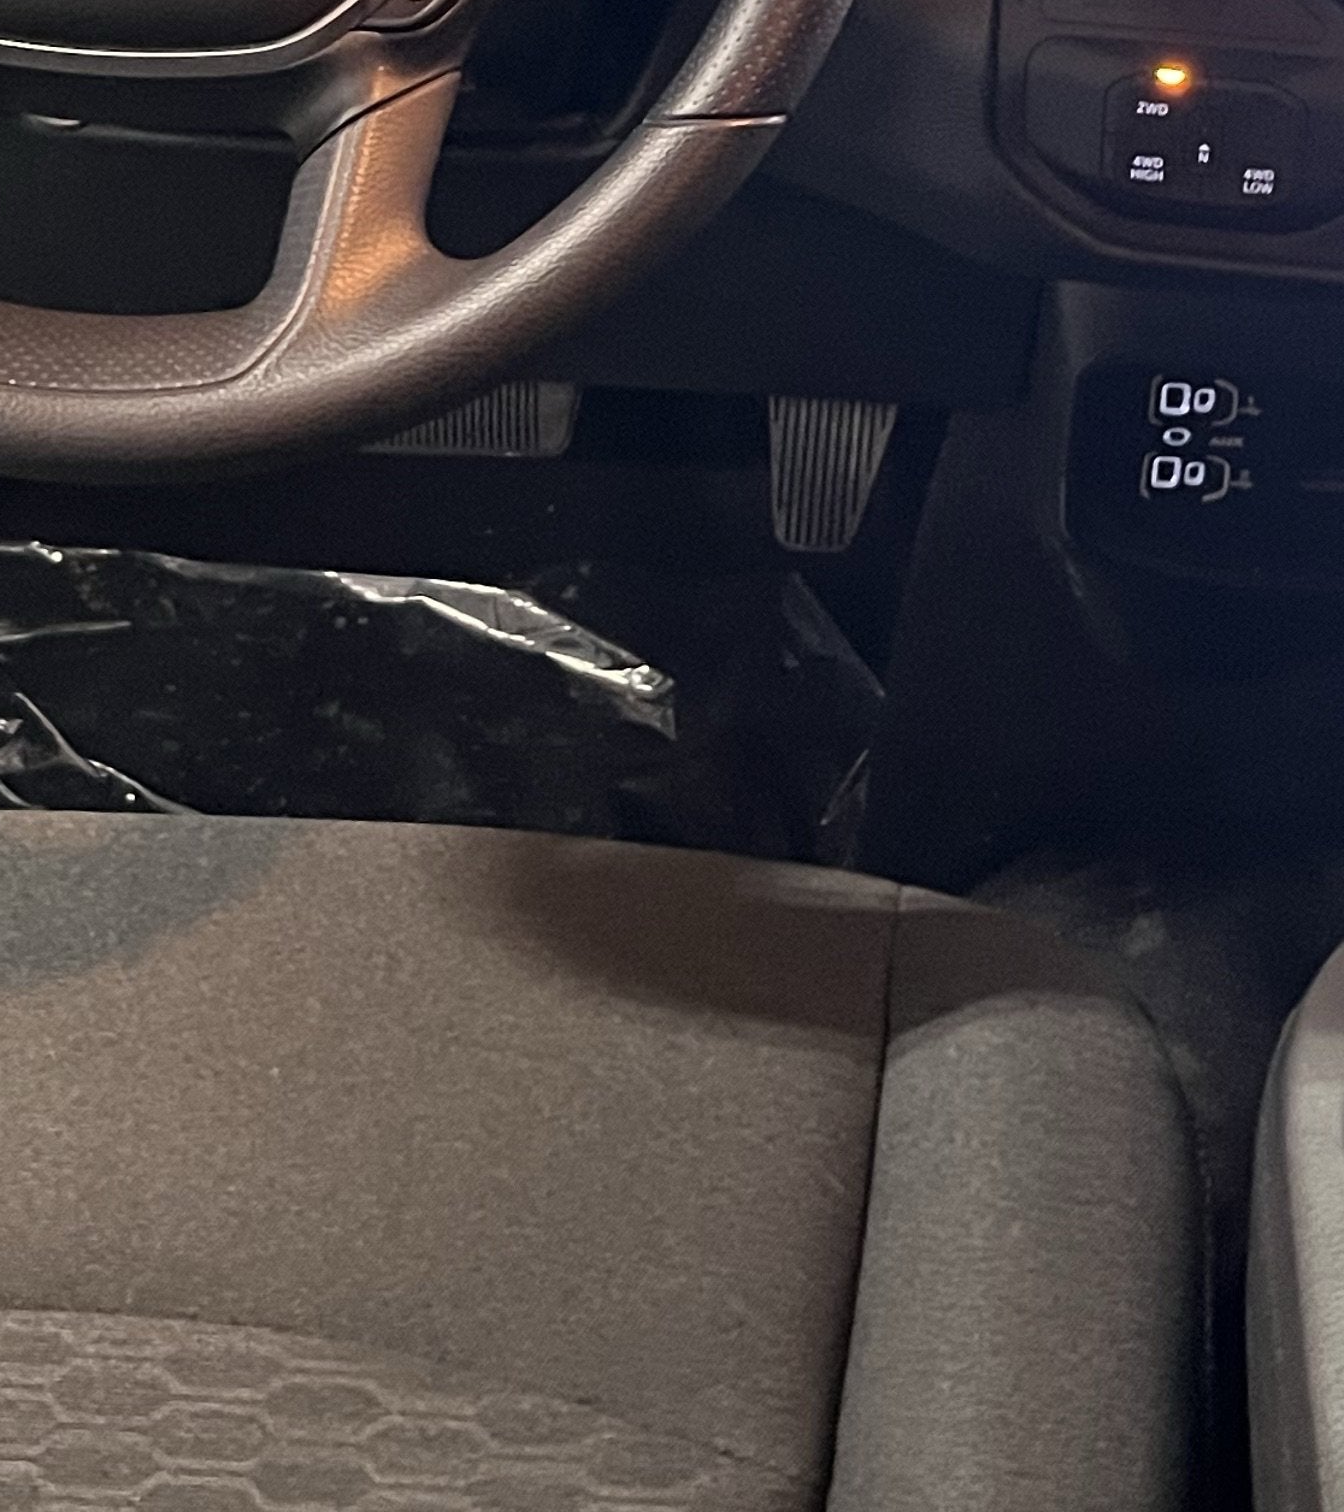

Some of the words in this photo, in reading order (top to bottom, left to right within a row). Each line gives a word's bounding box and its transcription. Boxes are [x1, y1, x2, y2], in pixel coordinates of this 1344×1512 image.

[1136, 101, 1169, 116] 2WD
[1132, 156, 1164, 168] 4WD
[1130, 169, 1164, 182] HIGH
[1243, 169, 1275, 181] 4WD
[1243, 181, 1274, 194] LOW
